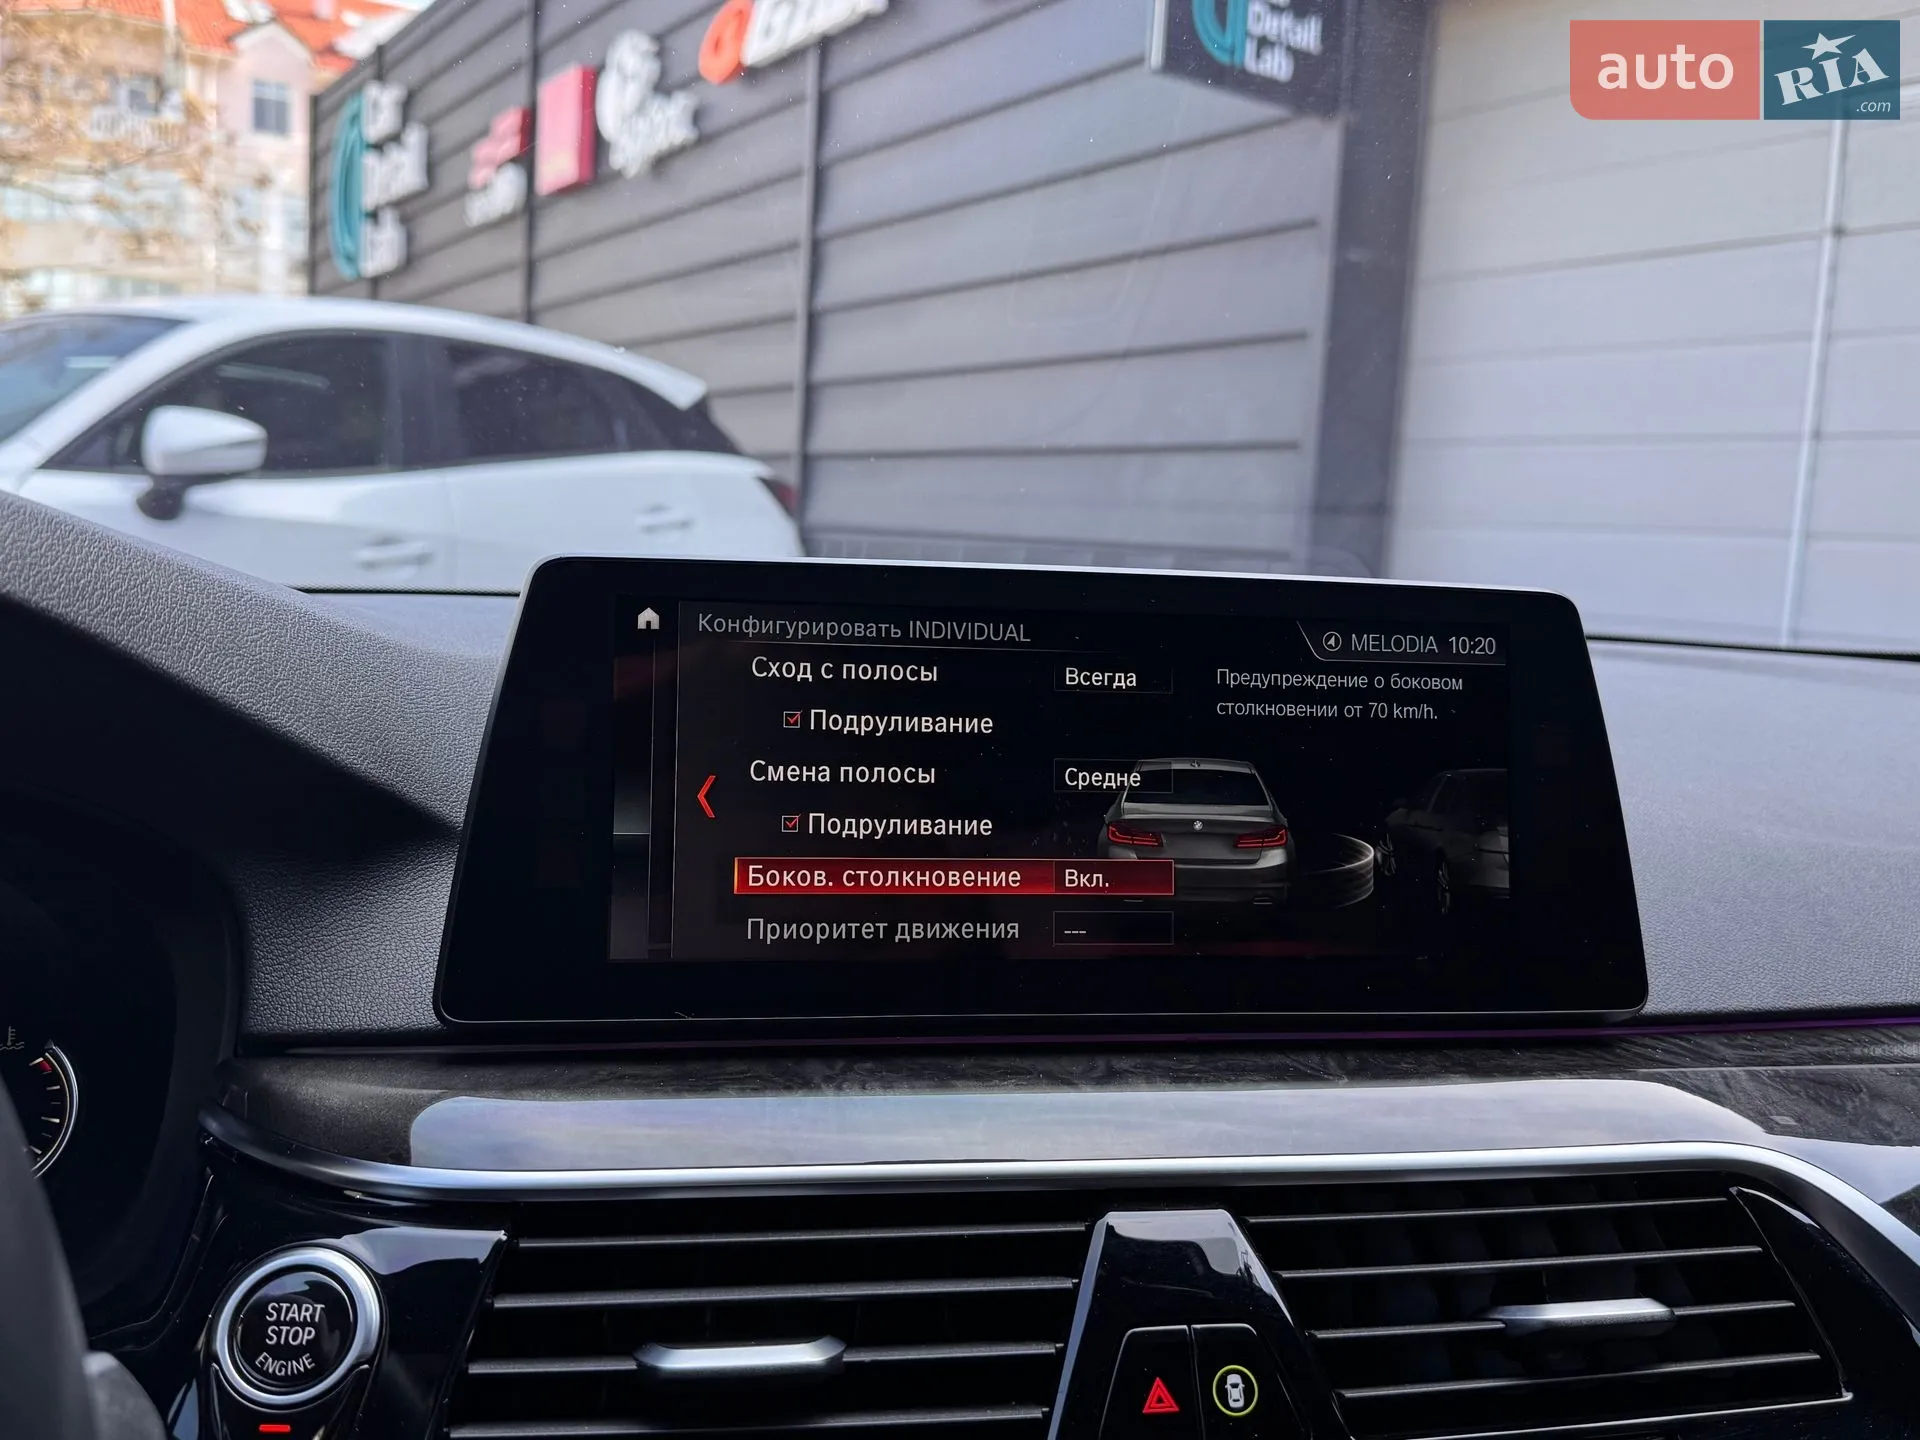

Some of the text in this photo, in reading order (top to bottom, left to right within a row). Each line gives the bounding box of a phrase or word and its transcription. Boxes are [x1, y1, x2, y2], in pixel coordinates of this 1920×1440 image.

[1244, 37, 1295, 83] Lab
[698, 613, 1031, 643] Конфигурировать INDIVIDUAL
[1351, 633, 1496, 656] MELODIA 10:20
[751, 656, 938, 682] Сход с полосы
[1064, 667, 1138, 689] Всегда
[1217, 668, 1463, 690] Предупреждение о боковом
[809, 709, 994, 736] Подруливание
[1216, 702, 1438, 720] столкновении от 70 km/h.
[750, 759, 936, 784] Смена полосы
[1064, 767, 1141, 789] Средне
[808, 812, 993, 839] Подруливание
[748, 864, 1021, 888] Боков. столкновение
[1064, 868, 1109, 888] Вкл.
[747, 918, 1020, 944] Приоритет движения
[265, 1302, 325, 1323] START
[265, 1325, 316, 1346] STOP
[255, 1351, 315, 1376] ENGINE
